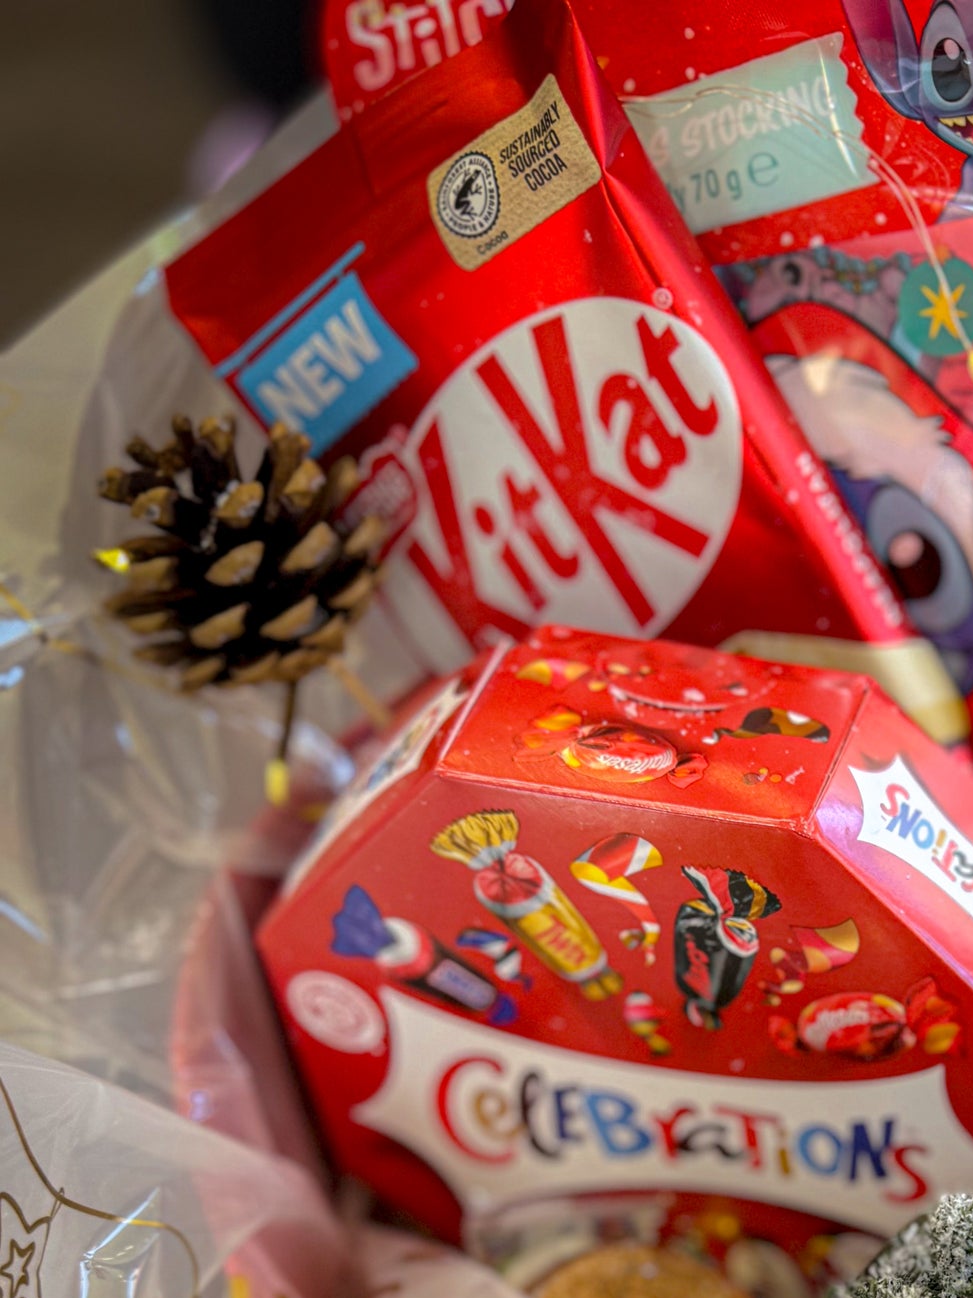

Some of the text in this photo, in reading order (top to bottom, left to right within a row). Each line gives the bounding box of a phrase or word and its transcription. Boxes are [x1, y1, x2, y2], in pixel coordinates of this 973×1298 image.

[499, 100, 561, 164] SUSTAINABLY
[508, 129, 561, 179] SOURCED
[524, 153, 568, 192] COCOA
[689, 168, 720, 204] 70
[726, 169, 743, 201] g
[476, 229, 510, 255] Cocoa
[257, 298, 383, 432] NEW
[406, 313, 721, 656] KitKat
